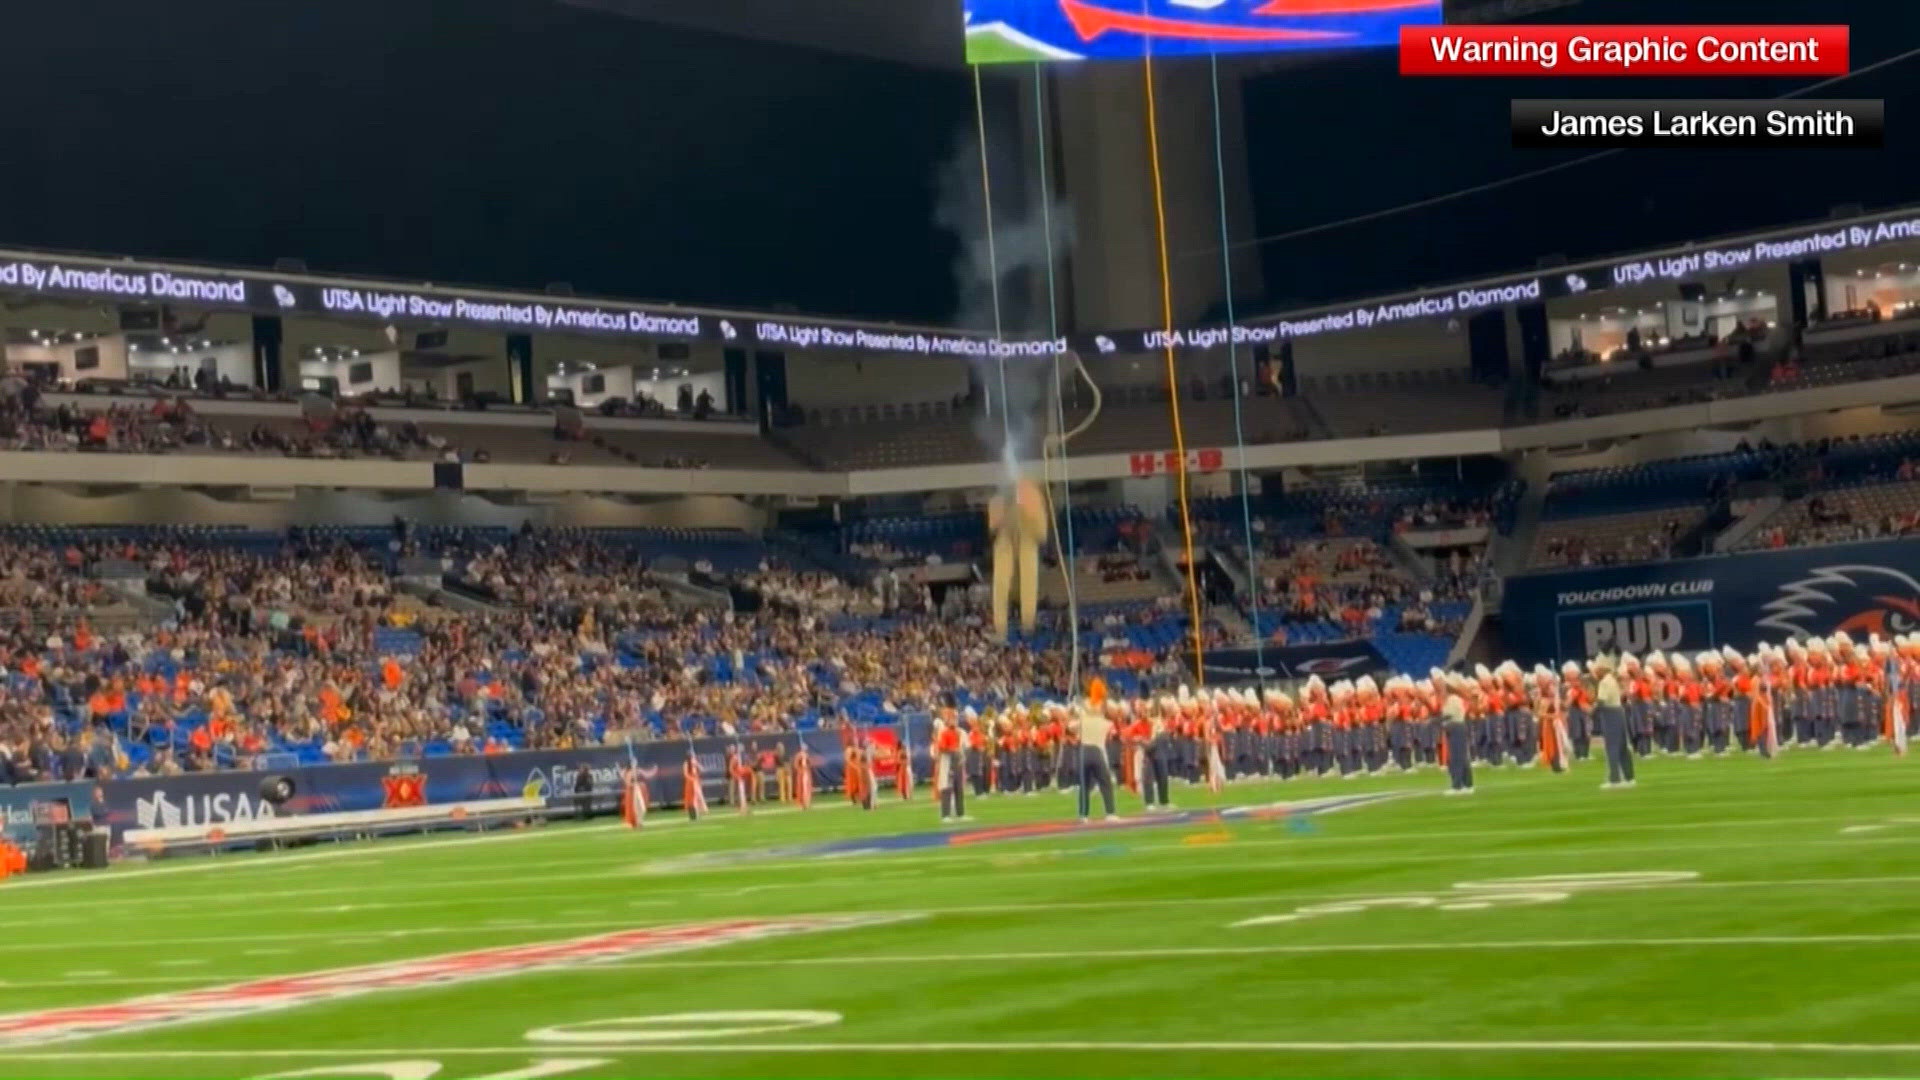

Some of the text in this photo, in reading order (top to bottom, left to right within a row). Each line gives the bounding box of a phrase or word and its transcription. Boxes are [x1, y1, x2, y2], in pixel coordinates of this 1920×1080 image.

[1613, 262, 1656, 284] UTSA
[1658, 254, 1700, 278] Light
[1703, 248, 1752, 268] Show
[1755, 230, 1846, 260] Presented
[1849, 225, 1873, 248] By
[22, 263, 46, 291] By
[48, 264, 147, 295] Americus
[150, 272, 245, 302] Diamond
[323, 288, 700, 336] UTSA Light Show Presented By Americus Diamond
[1143, 278, 1541, 349] UTSA Light Show Presented By Americus Diamond
[756, 322, 788, 341] UTSA
[789, 325, 820, 347] Light
[821, 327, 855, 346] Show
[988, 336, 1068, 356] Diamond
[1557, 579, 1714, 605] TOUCHDOWN CLUB
[186, 791, 275, 827] USAA
